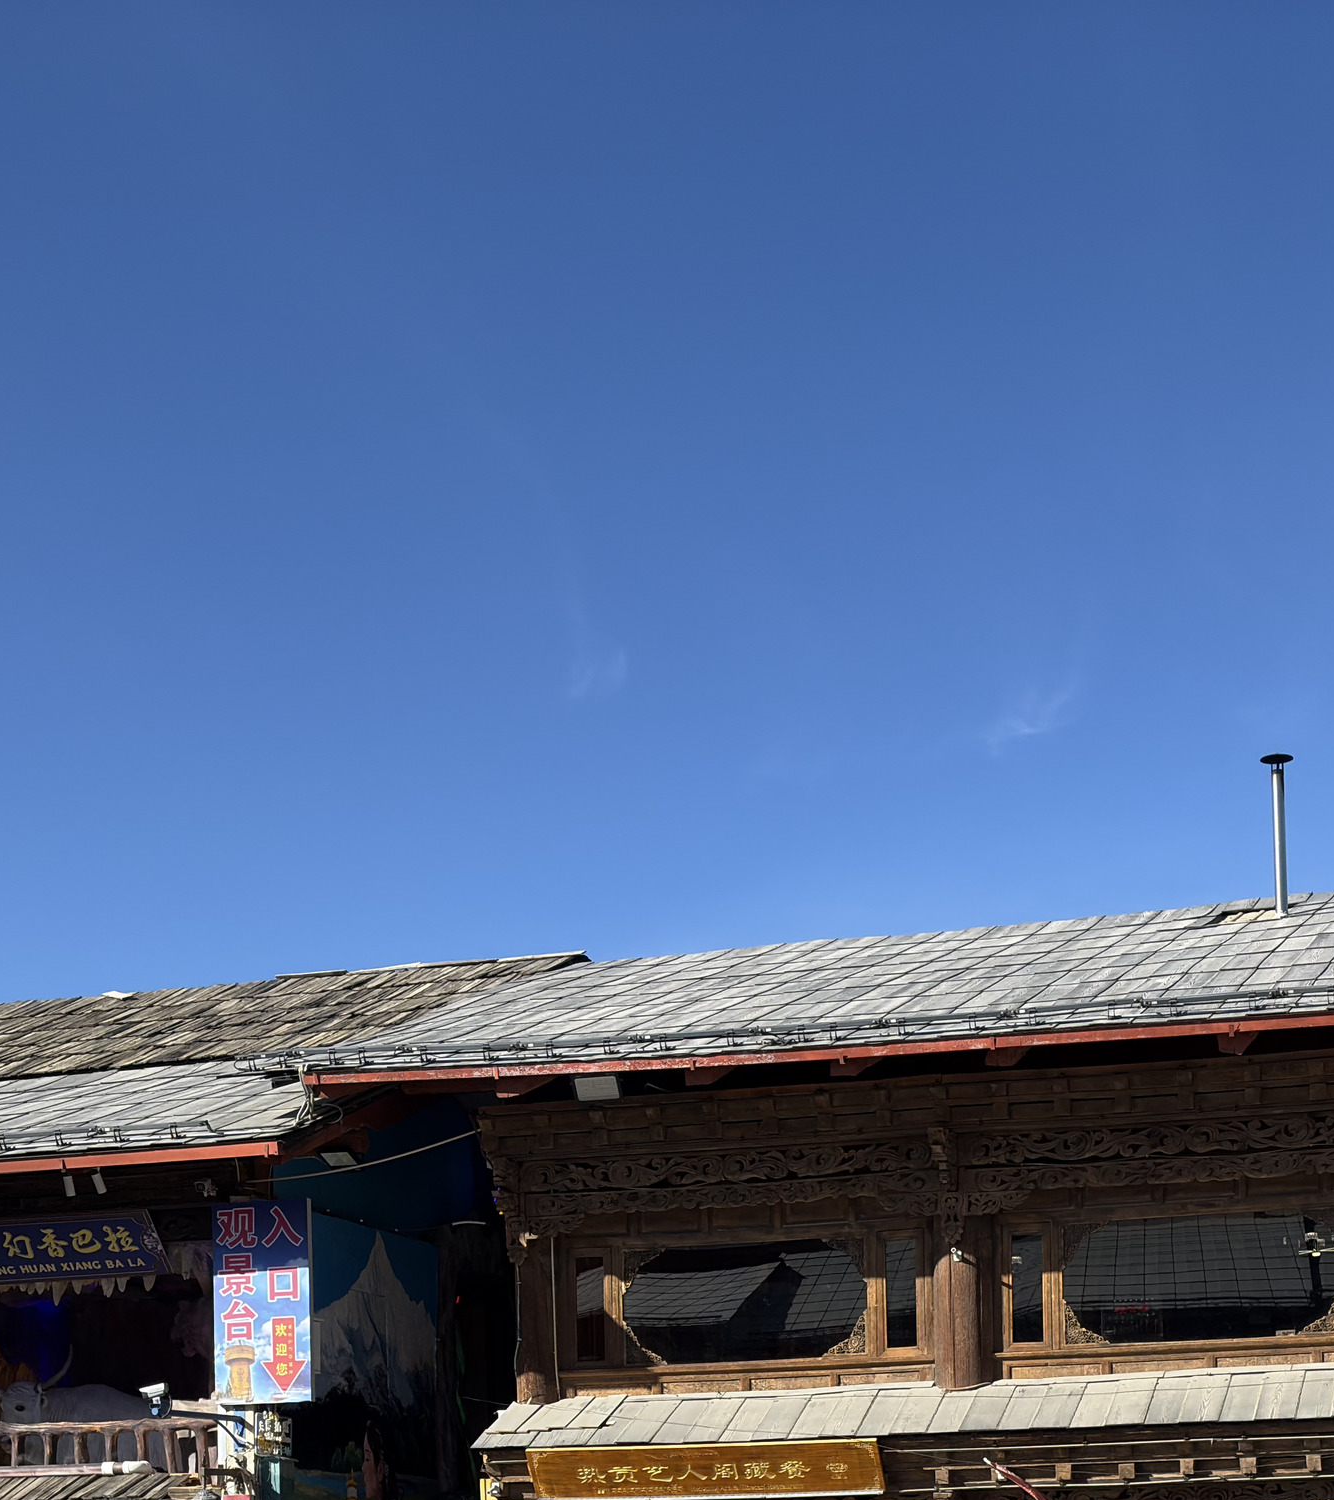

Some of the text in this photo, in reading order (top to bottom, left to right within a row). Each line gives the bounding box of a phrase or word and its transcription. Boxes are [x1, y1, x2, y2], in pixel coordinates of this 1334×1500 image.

[19, 1264, 57, 1275] HUAN
[61, 1260, 102, 1272] XIANG
[107, 1259, 125, 1269] BA
[127, 1257, 147, 1268] LA
[216, 1207, 258, 1343] 观景台
[262, 1206, 303, 1302] 入口
[275, 1323, 288, 1376] 欢迎您
